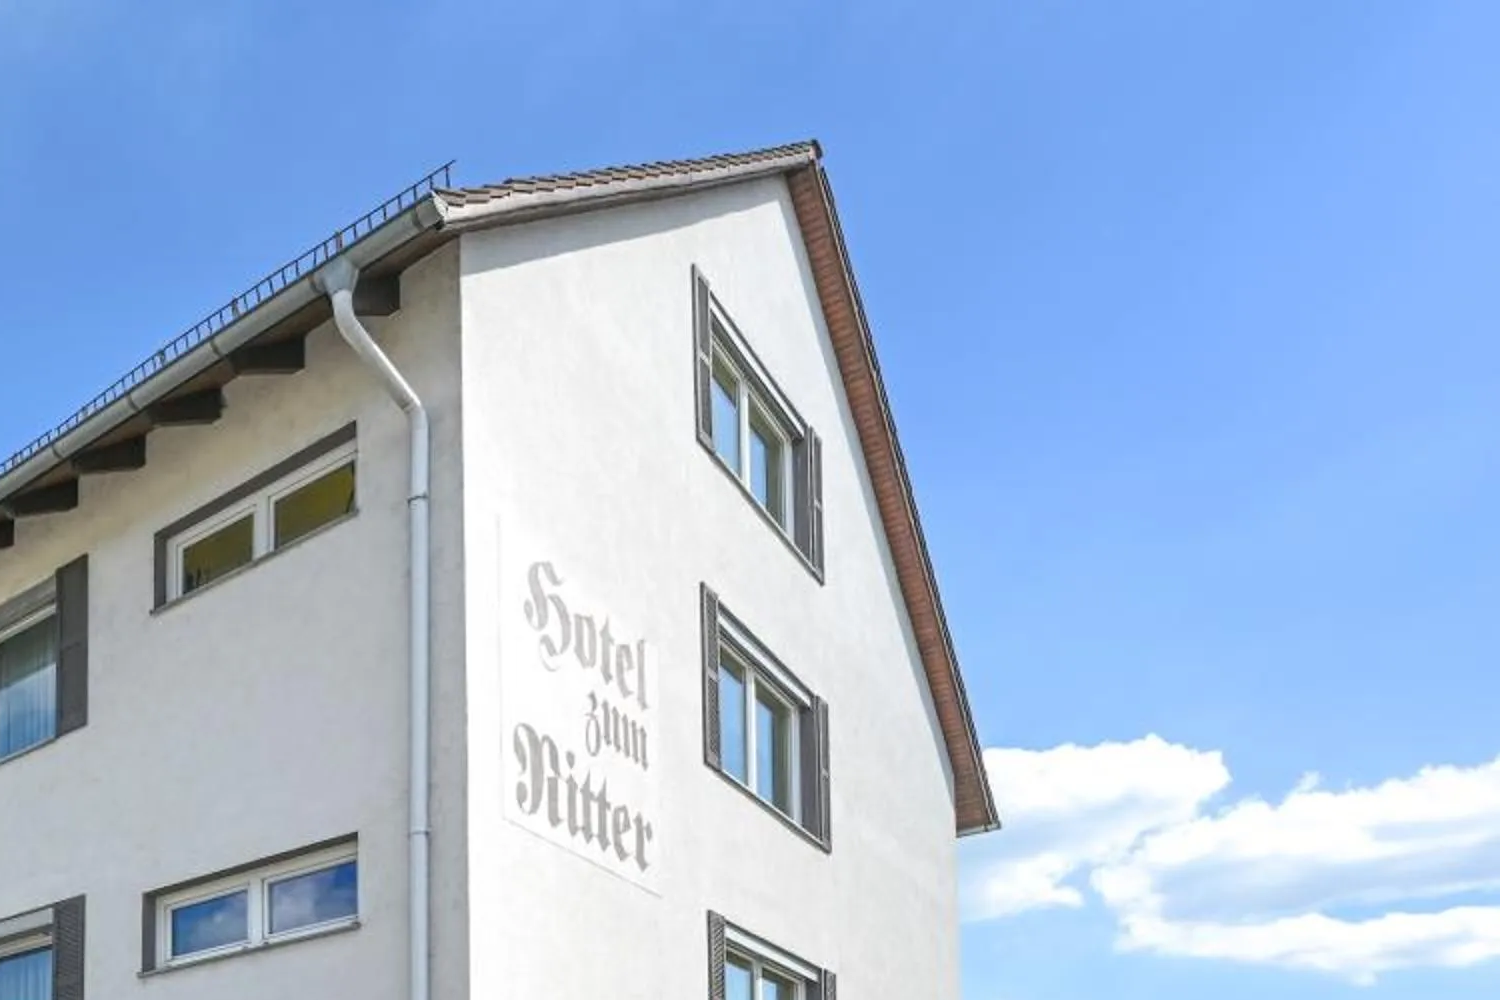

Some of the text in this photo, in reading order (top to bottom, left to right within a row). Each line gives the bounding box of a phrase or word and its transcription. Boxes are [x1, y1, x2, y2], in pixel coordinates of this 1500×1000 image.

[523, 560, 649, 711] Hotel
[513, 722, 653, 871] Ritter
[585, 691, 649, 771] zum
